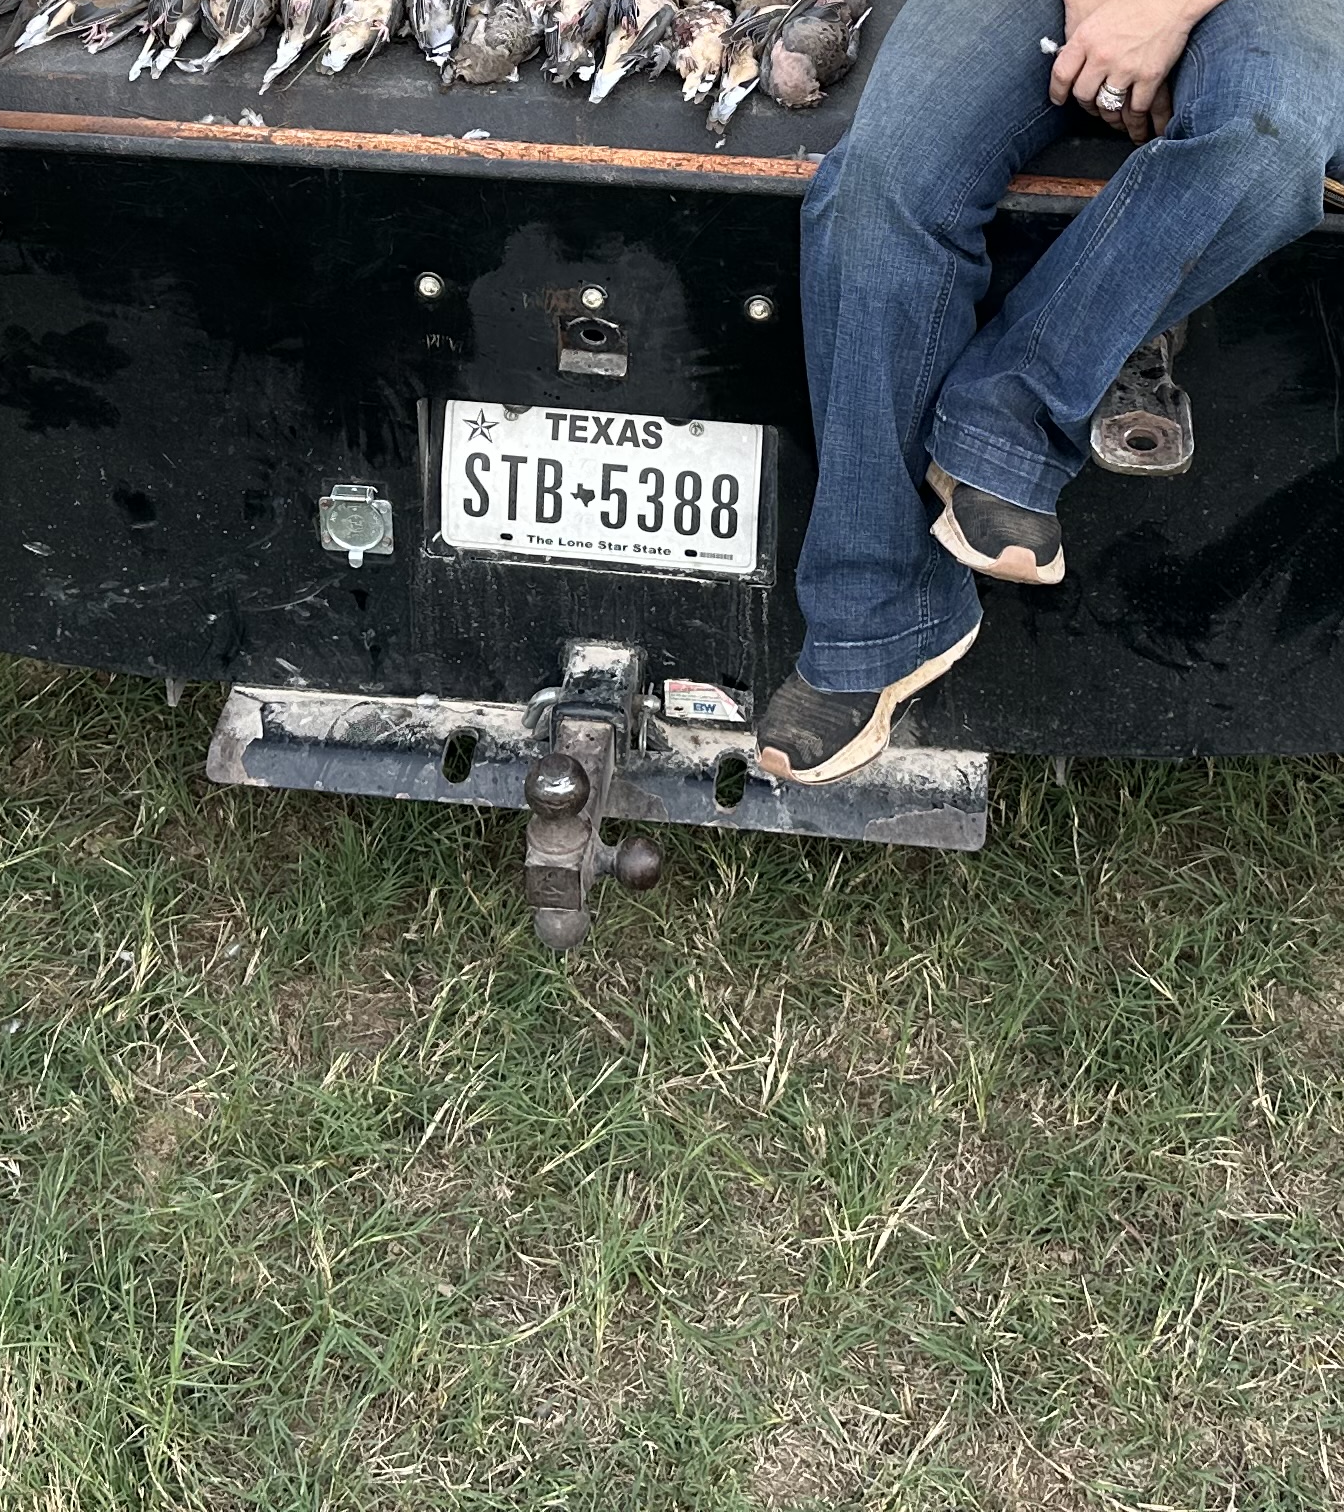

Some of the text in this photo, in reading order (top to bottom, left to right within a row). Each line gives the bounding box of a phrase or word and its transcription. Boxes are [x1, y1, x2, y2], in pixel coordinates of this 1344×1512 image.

[545, 412, 664, 449] TEXAS
[463, 452, 739, 539] STB 5388
[527, 535, 672, 556] The Lone Star State
